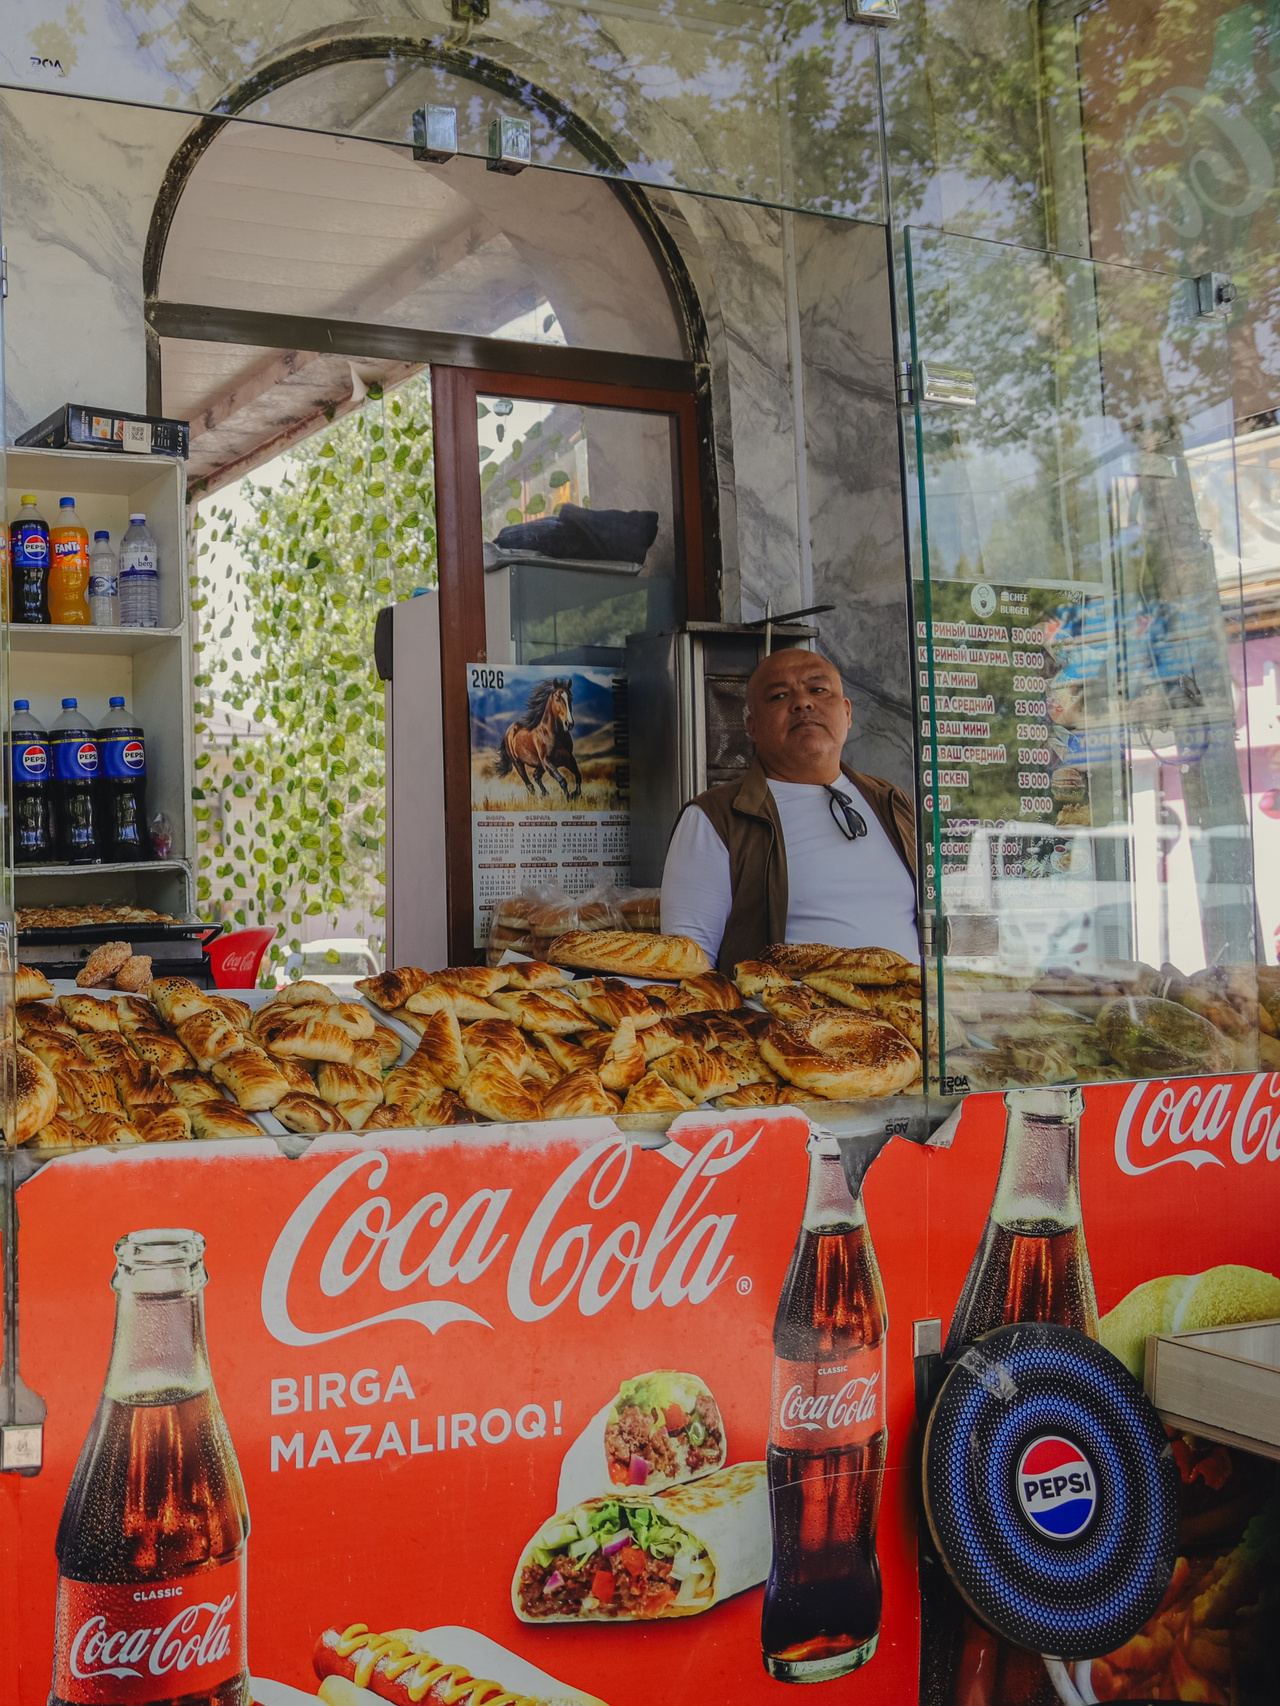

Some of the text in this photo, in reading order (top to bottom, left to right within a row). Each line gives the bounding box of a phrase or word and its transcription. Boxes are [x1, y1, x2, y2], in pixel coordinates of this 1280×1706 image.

[137, 557, 153, 569] berg
[1009, 593, 1028, 602] CHEF
[1000, 605, 1029, 616] BURGER
[969, 626, 1008, 641] ШАУРМА
[1012, 628, 1024, 643] 30
[1026, 629, 1044, 644] 000
[970, 651, 1009, 666] ШАУРМА
[1013, 653, 1024, 667] 35
[1026, 653, 1044, 668] 000
[472, 669, 504, 689] 2026
[951, 674, 977, 689] МИНИ
[1014, 676, 1025, 691] 20
[1027, 677, 1045, 692] 000
[951, 697, 994, 715] СРЕДНИЙ
[1015, 700, 1026, 715] 25
[1028, 701, 1046, 716] 000
[963, 722, 989, 737] МИНИ
[1018, 724, 1029, 739] 25
[1030, 725, 1048, 740] 000
[964, 745, 1006, 764] СРЕДНИЙ
[1019, 750, 1030, 763] 30
[1032, 750, 1050, 764] 000
[1019, 773, 1030, 787] 35
[1032, 773, 1049, 787] 000
[1021, 798, 1032, 811] 30
[1035, 797, 1052, 812] 000
[1001, 843, 1019, 855] 000
[1005, 864, 1022, 877] 000
[817, 1365, 849, 1375] CLASSIC
[270, 1365, 415, 1415] BIRGA
[780, 1373, 879, 1430] Coca-Cola
[270, 1401, 564, 1472] MAZALIROQ!
[1023, 1474, 1090, 1503] PEPSI
[133, 1586, 183, 1601] CLASSIC
[70, 1590, 237, 1678] Coca-Cola
